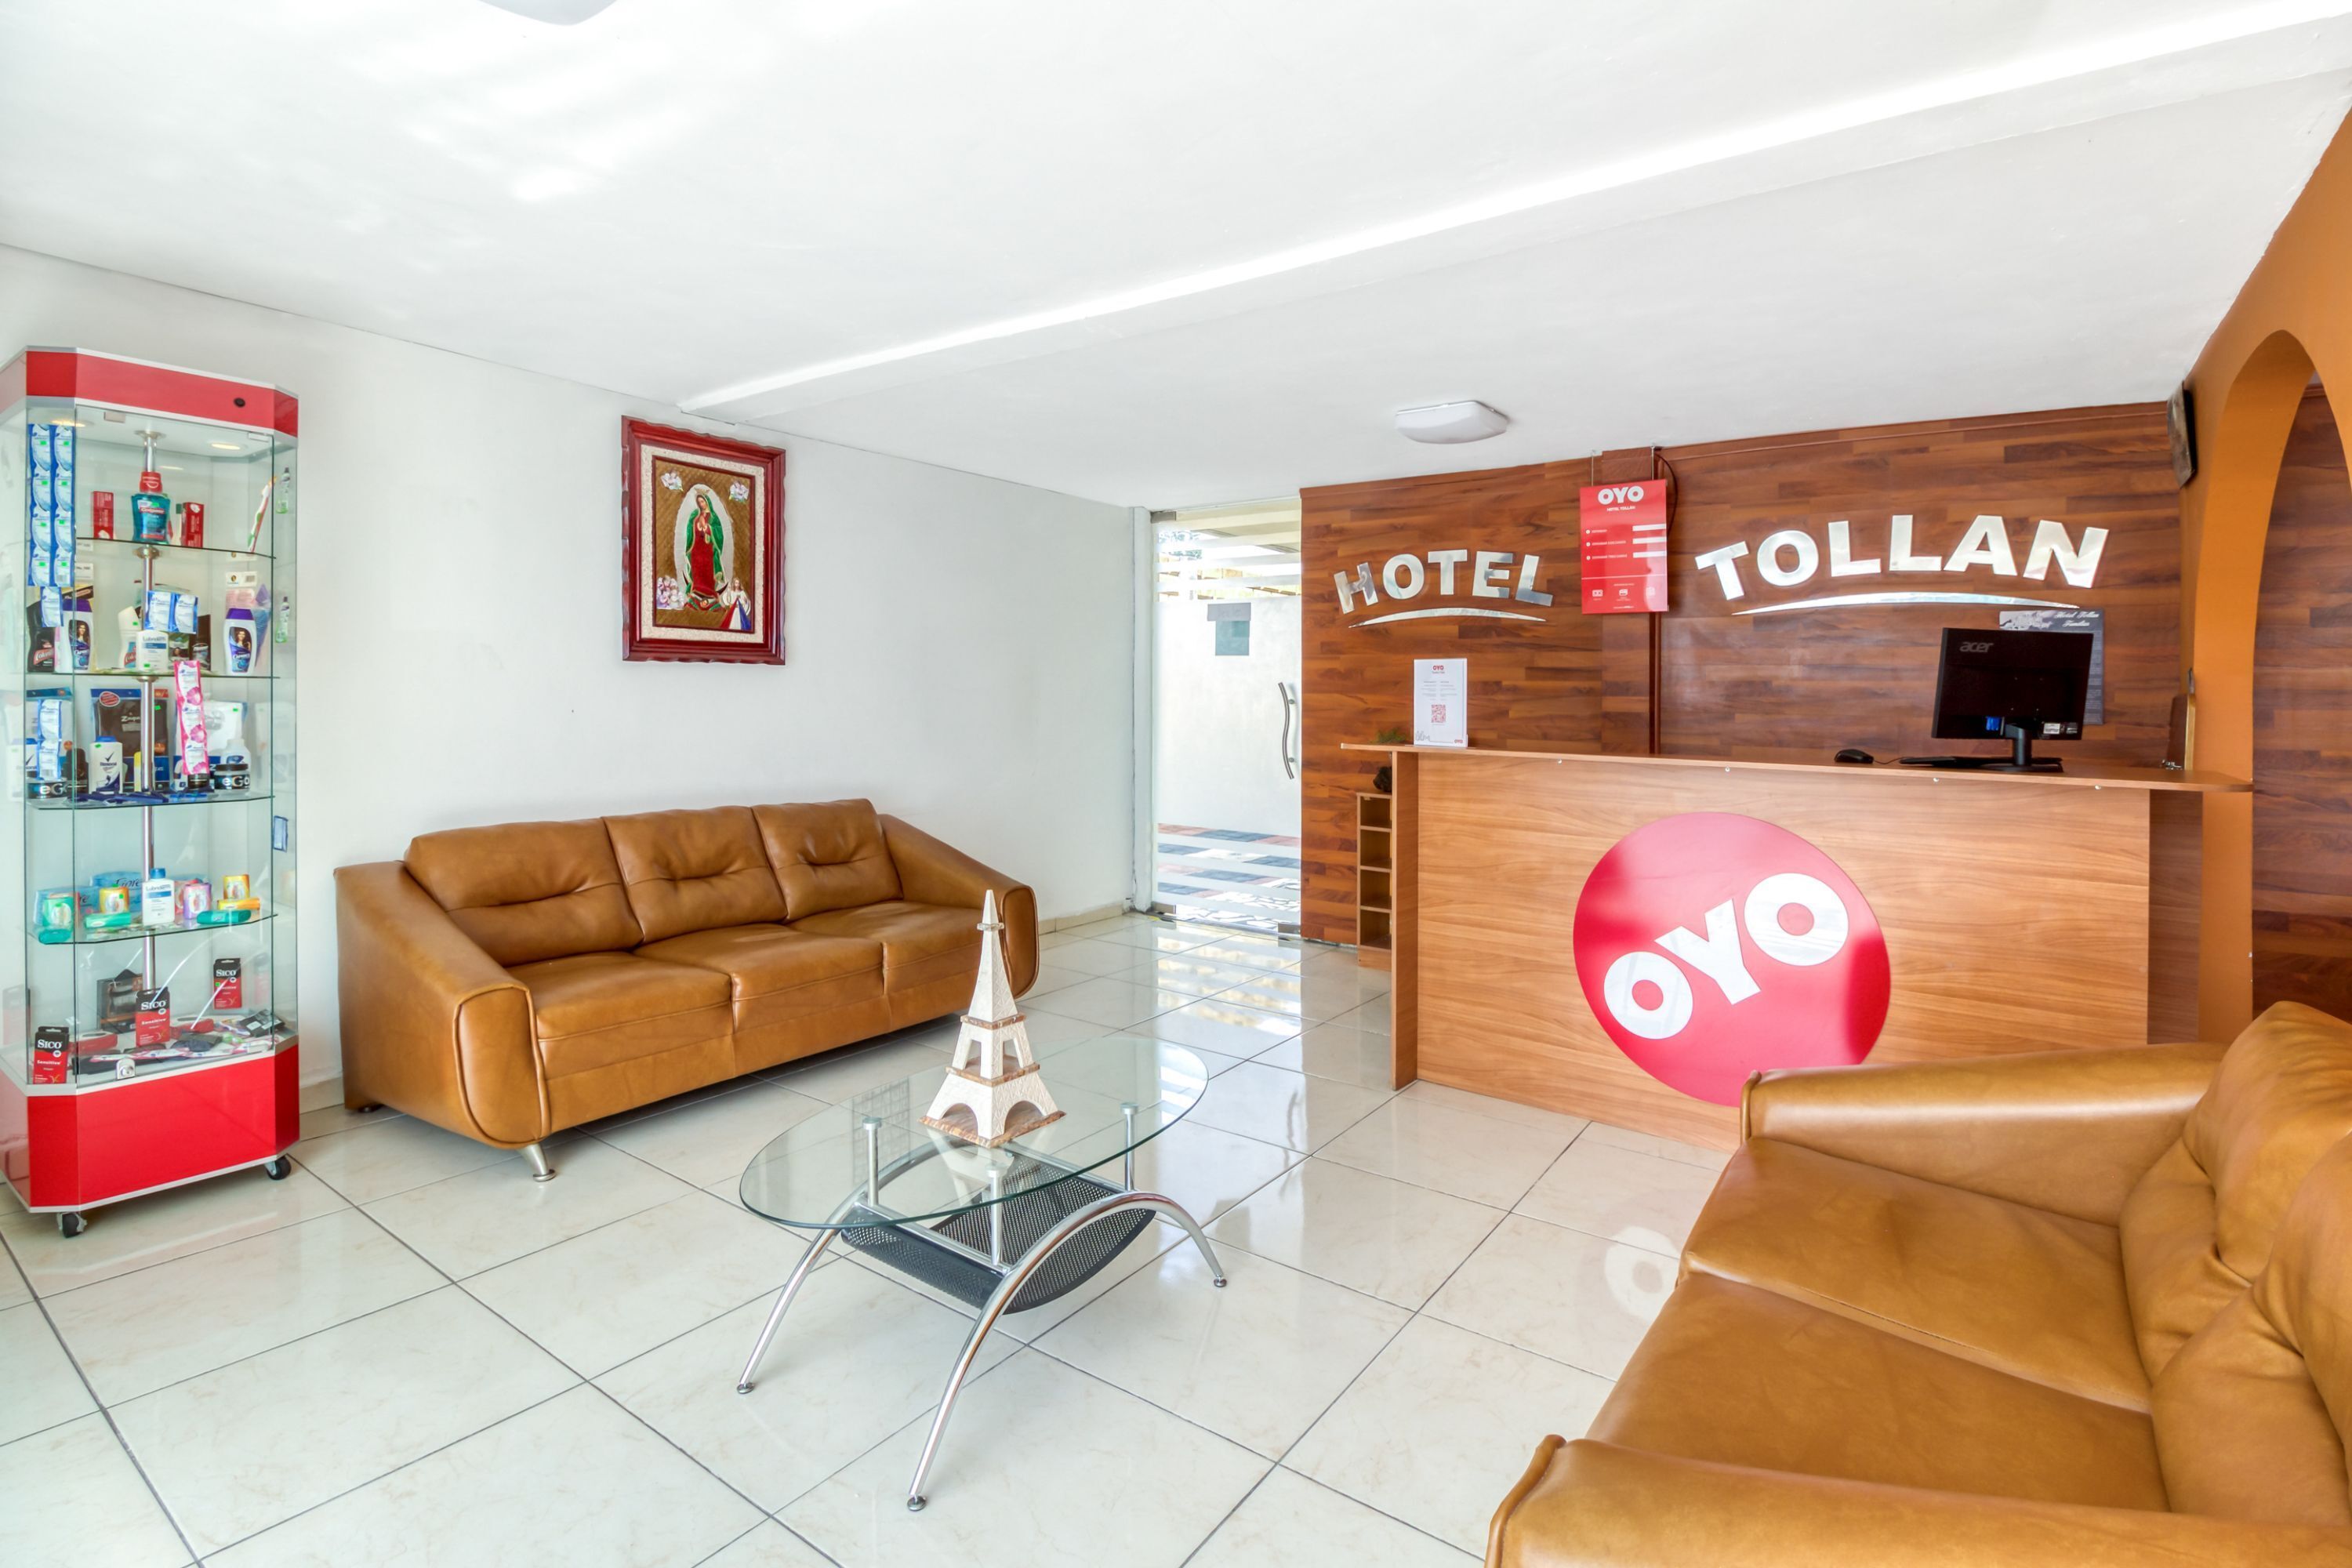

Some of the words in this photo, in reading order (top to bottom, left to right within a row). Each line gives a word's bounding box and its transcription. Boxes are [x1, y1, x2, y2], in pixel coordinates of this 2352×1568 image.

[1598, 485, 1644, 505] OYO
[1334, 549, 1553, 615] HOTEL
[1695, 514, 2110, 601] TOLLAN
[1959, 641, 1994, 652] acer
[1603, 873, 1849, 1040] OYO
[141, 1000, 166, 1011] SICO
[37, 1039, 62, 1049] SICO
